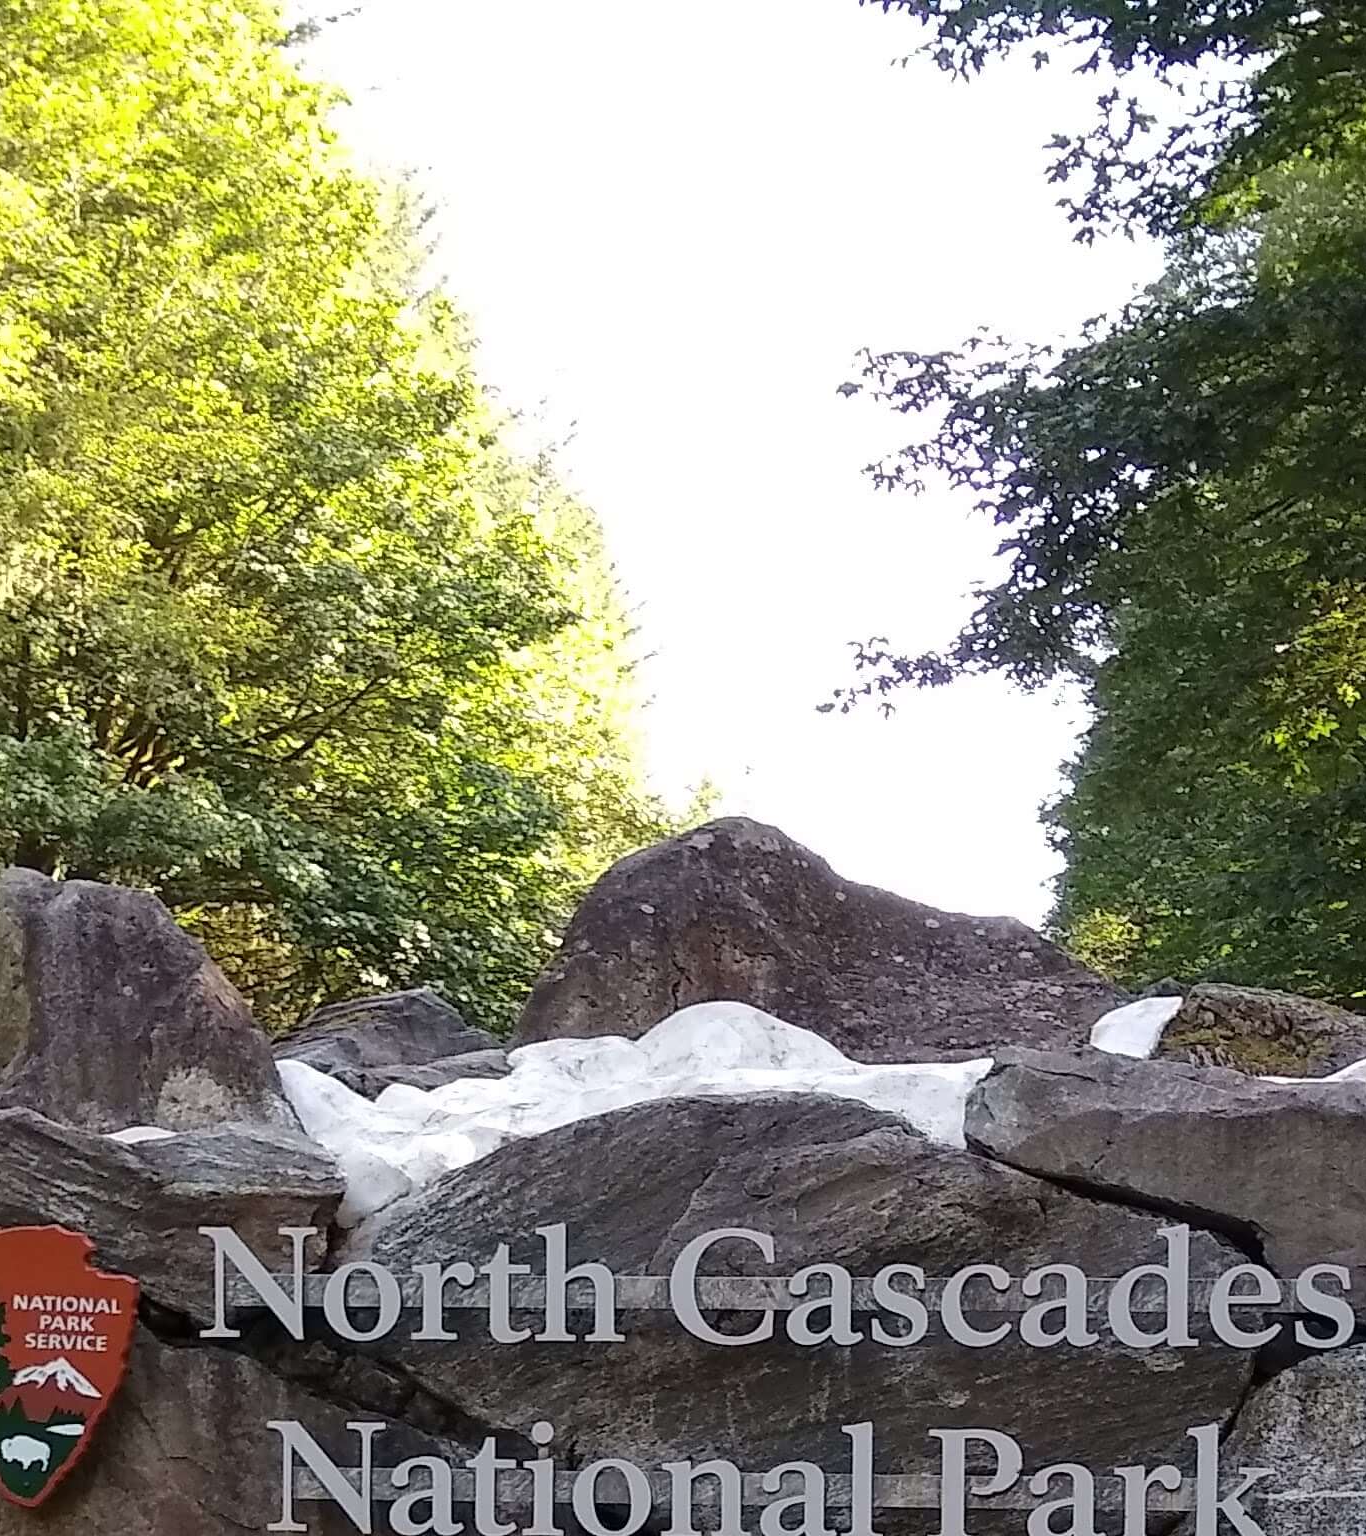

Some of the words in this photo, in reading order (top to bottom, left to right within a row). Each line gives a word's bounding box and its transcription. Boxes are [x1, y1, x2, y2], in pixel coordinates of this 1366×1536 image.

[199, 1224, 626, 1343] North
[670, 1223, 1356, 1349] Cascades
[13, 1295, 122, 1314] NATIONAL
[40, 1315, 94, 1332] PARK
[25, 1333, 108, 1351] SERVICE
